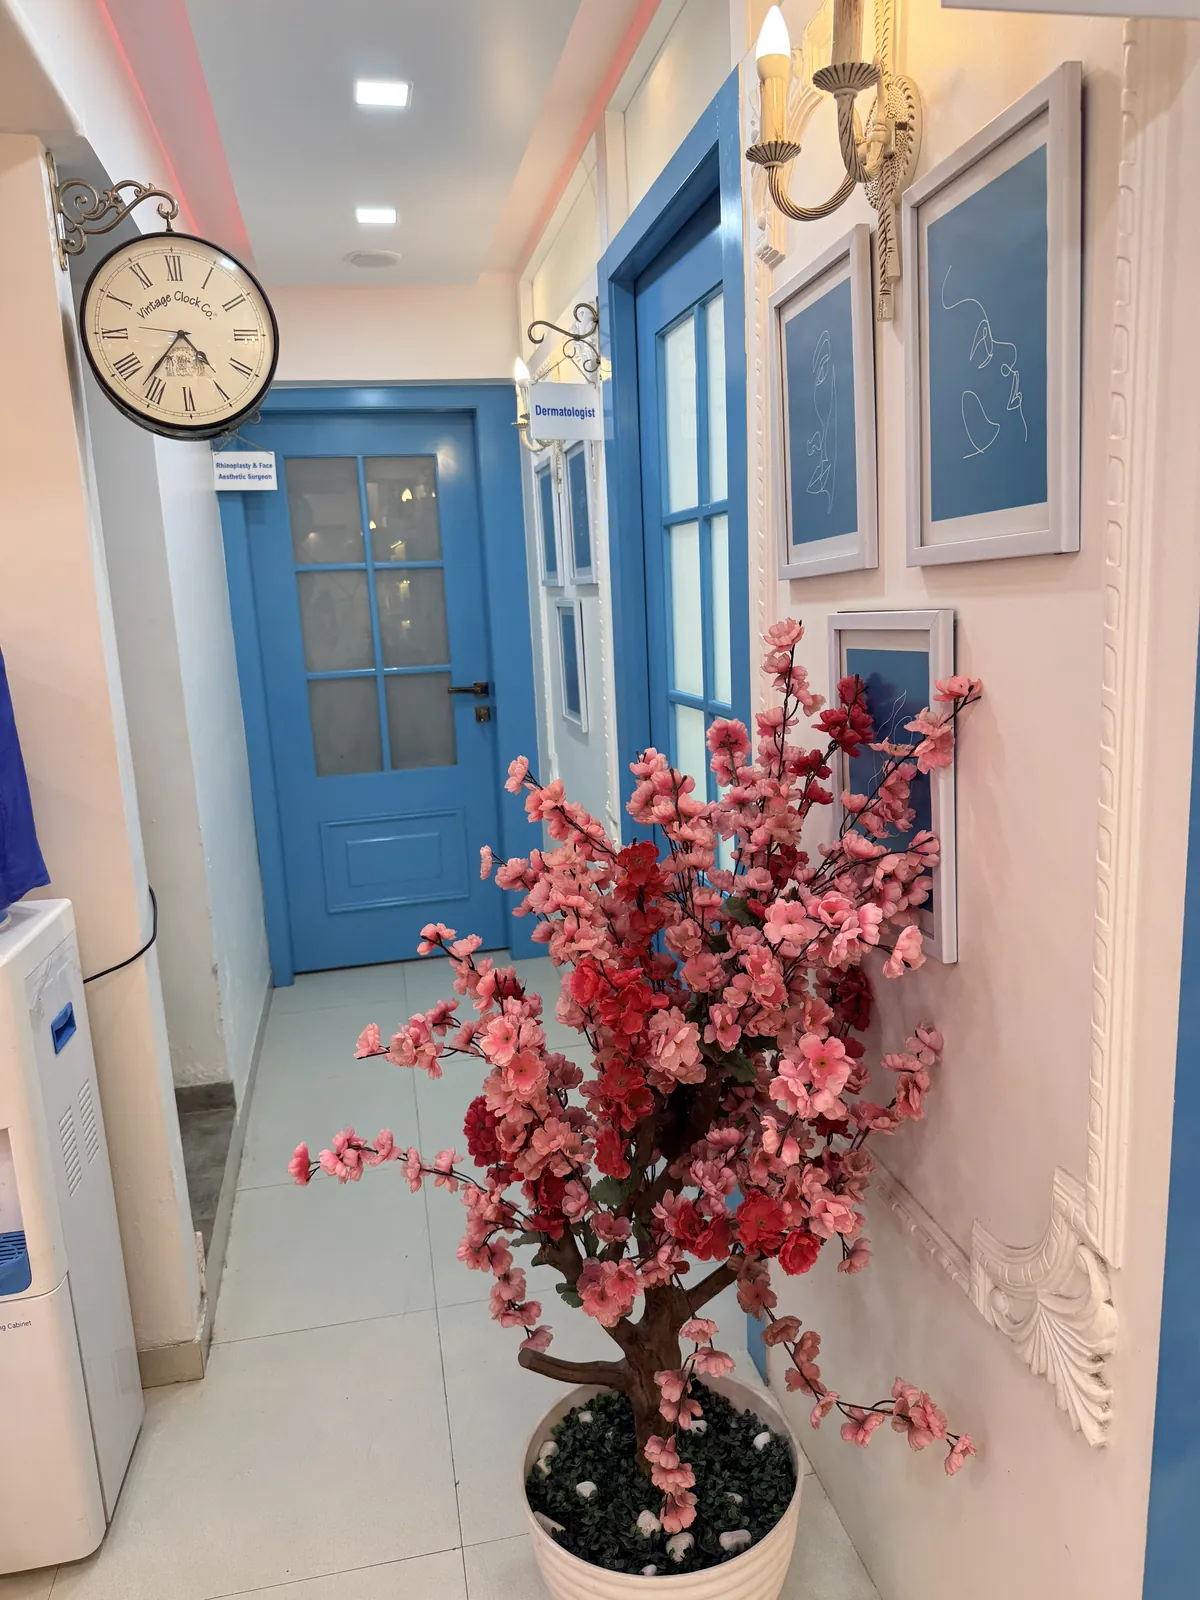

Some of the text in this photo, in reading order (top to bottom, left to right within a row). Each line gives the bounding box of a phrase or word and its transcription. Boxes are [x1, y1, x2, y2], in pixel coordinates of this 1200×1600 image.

[129, 263, 153, 290] XI
[164, 255, 183, 281] XII
[201, 267, 214, 289] I
[105, 291, 133, 310] X
[136, 290, 213, 321] Vintage Clock Co.
[222, 294, 246, 312] II
[101, 327, 129, 340] IX
[233, 329, 258, 341] III
[113, 352, 143, 381] VIII
[145, 376, 166, 404] VII
[535, 404, 595, 420] Dermatologist
[215, 462, 251, 471] Rhinoplasty
[247, 473, 273, 481] Surgeon
[7, 1321, 31, 1330] Cabinet
